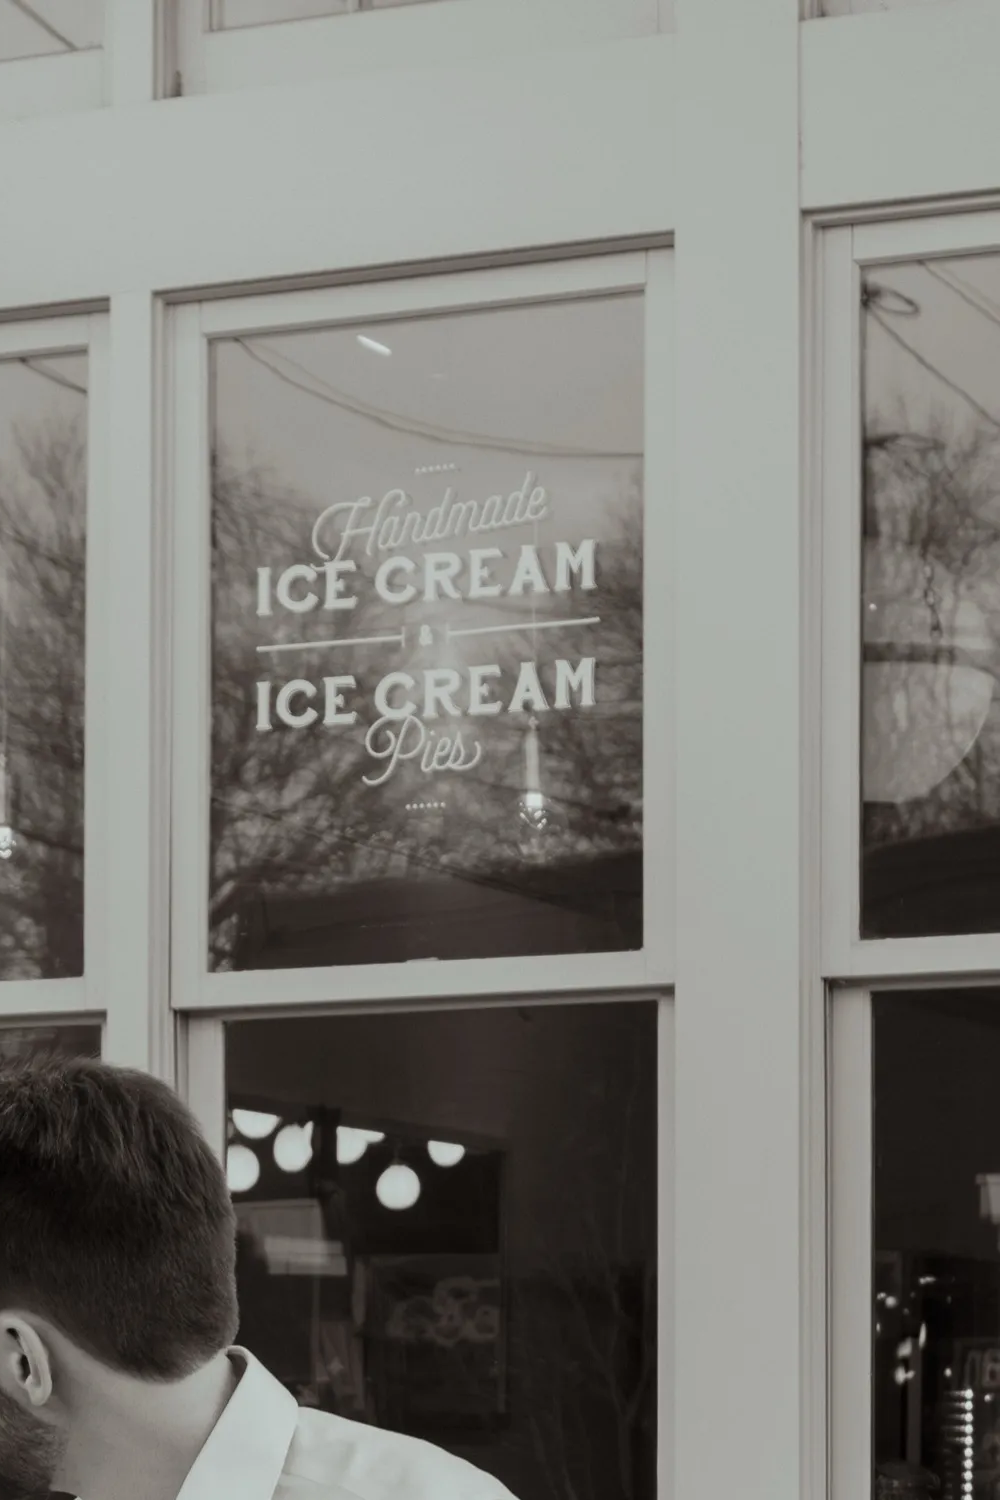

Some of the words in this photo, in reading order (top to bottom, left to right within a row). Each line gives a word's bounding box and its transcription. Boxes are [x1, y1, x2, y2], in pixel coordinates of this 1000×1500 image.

[311, 471, 549, 572] Handmade
[256, 560, 358, 616] ICE
[374, 538, 598, 605] CREAM
[418, 624, 434, 647] &
[256, 675, 357, 731] ICE
[374, 657, 596, 720] CREAM
[362, 713, 482, 786] Pies
